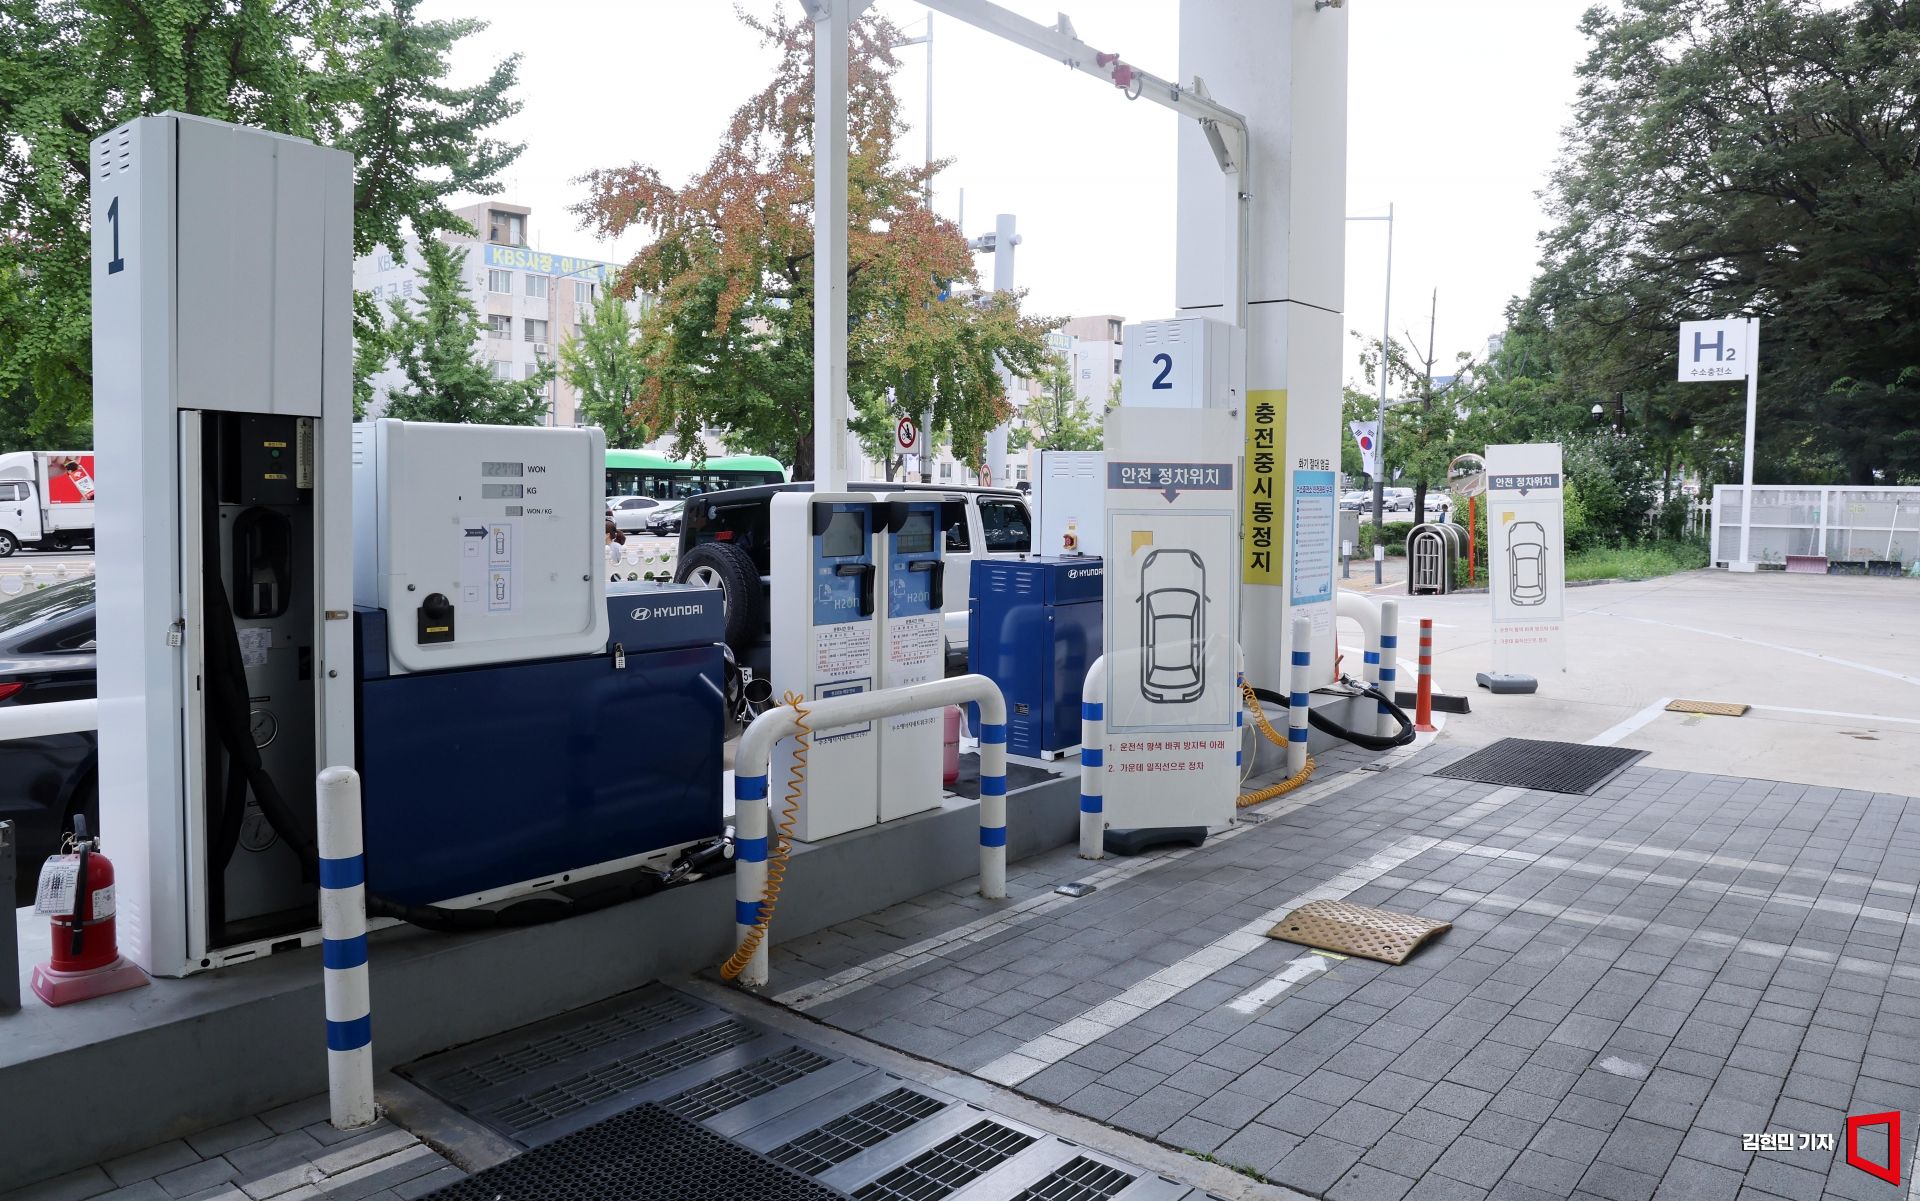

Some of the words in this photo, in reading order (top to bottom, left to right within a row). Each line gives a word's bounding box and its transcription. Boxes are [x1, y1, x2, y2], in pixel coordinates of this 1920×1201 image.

[107, 195, 124, 275] 1
[378, 255, 398, 273] KB
[1152, 353, 1173, 390] 2
[1690, 367, 1733, 377] 수소충전소
[527, 465, 546, 473] WON
[1298, 458, 1308, 470] 화기
[1309, 458, 1319, 470] 절대
[1320, 459, 1330, 471] 엄금
[1121, 467, 1151, 485] 안전
[1159, 467, 1220, 486] 정차위치
[1495, 477, 1513, 488] 안전
[1516, 476, 1552, 487] 정차위치
[526, 487, 537, 495] KG
[1250, 403, 1276, 573] 충전중시동정지
[1079, 567, 1104, 577] HYUNDA
[653, 604, 703, 618] HYUNDAI
[1108, 743, 1115, 752] 1.
[1120, 742, 1143, 752] 운전석
[1147, 742, 1162, 752] 황색
[1165, 742, 1181, 751] 바퀴
[1184, 741, 1206, 751] 방지턱
[1209, 740, 1225, 750] 아래
[1108, 764, 1115, 773] 2.
[1120, 763, 1143, 773] 가운데
[1146, 762, 1185, 772] 일직선으로
[1188, 761, 1204, 771] 정차
